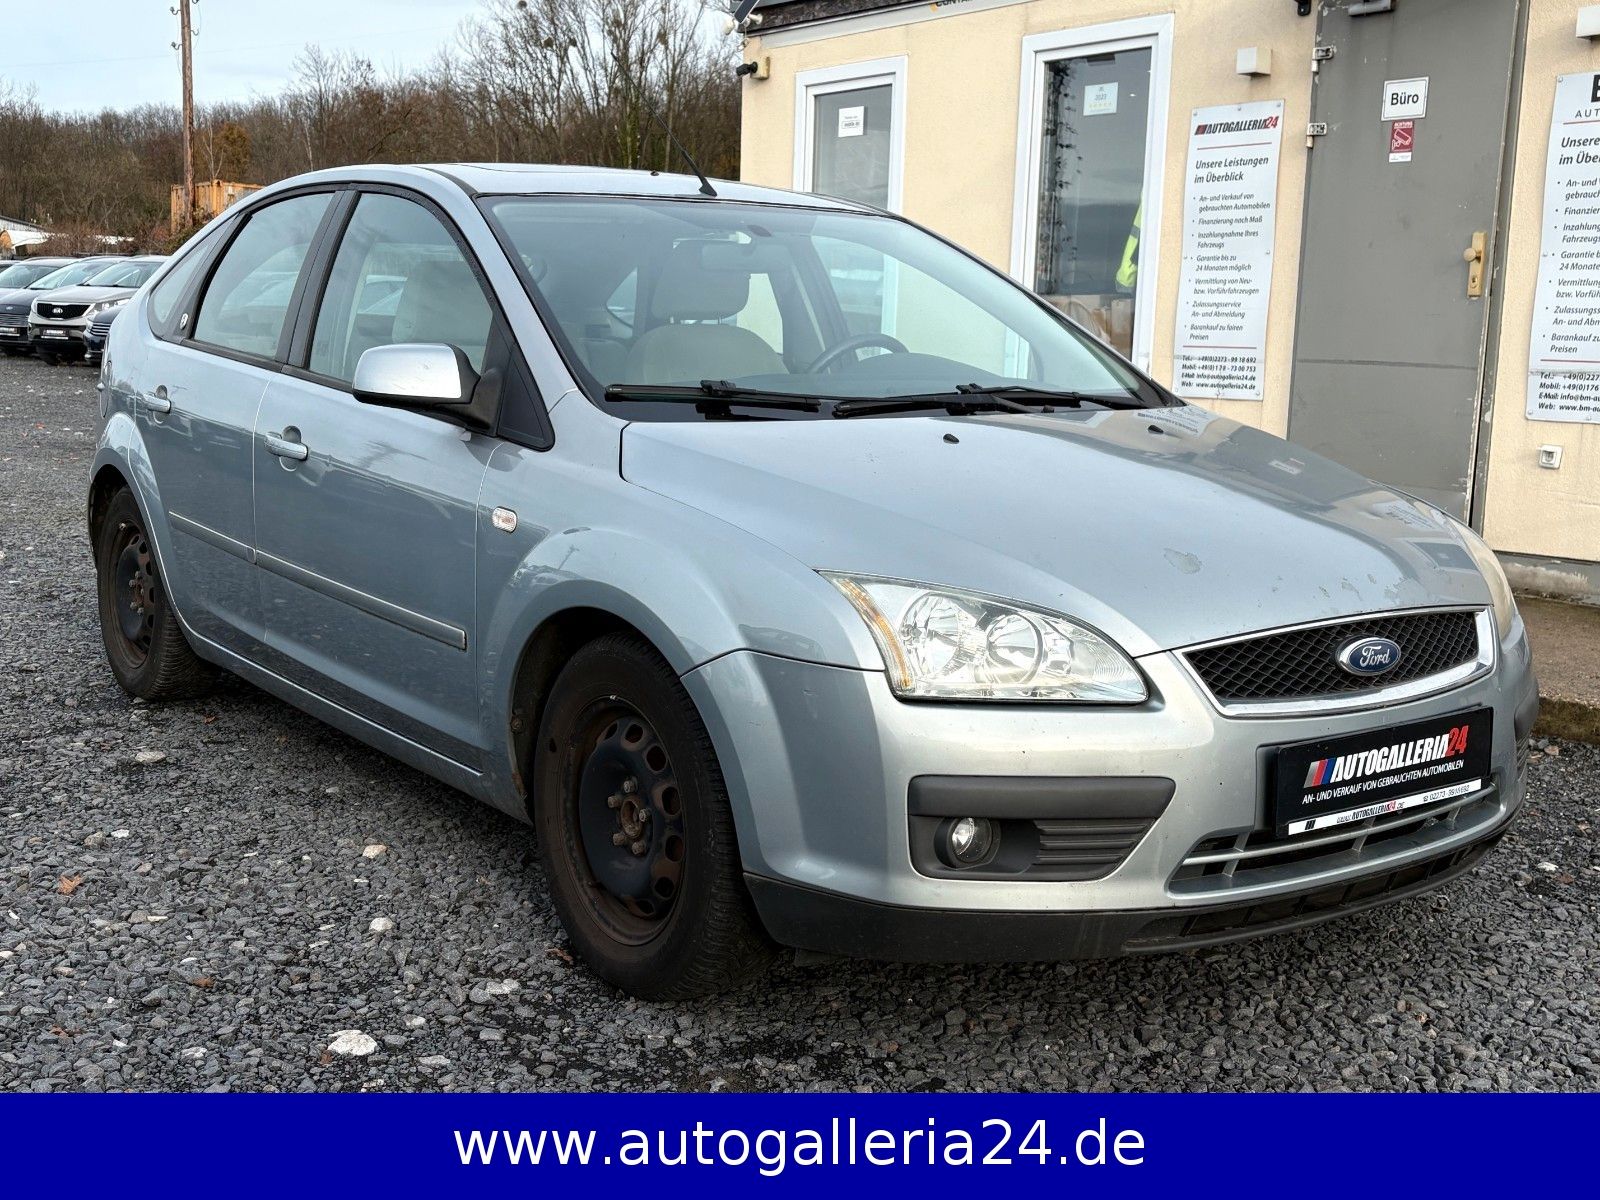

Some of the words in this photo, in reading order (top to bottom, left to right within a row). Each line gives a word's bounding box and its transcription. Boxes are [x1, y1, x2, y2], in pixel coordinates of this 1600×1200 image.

[1391, 92, 1419, 105] Büro
[1206, 115, 1279, 134] AUTOGALLERIA24
[1561, 136, 1600, 148] Unsere
[1559, 154, 1573, 165] im
[1576, 151, 1600, 164] Übe
[1195, 160, 1222, 169] Unsere
[1223, 157, 1269, 168] Leistungen
[1194, 174, 1204, 184] im
[1206, 171, 1244, 183] Überblick
[1566, 179, 1580, 187] An-
[1581, 178, 1598, 187] und
[1209, 194, 1221, 202] und
[1221, 193, 1243, 201] Verkauf
[1198, 204, 1233, 213] gebrauchten
[1233, 202, 1271, 210] Automobilen
[1198, 218, 1233, 227] Finanzierung
[1197, 230, 1244, 240] Inzahlungnahme
[1220, 254, 1229, 262] bis
[1560, 251, 1595, 259] Garantie
[1229, 264, 1252, 272] möglich
[1559, 263, 1569, 271] 24
[1194, 278, 1227, 286] Vermittlung
[1207, 287, 1260, 296] Vorführfahrzeugen
[1556, 290, 1573, 298] bzw.
[1192, 300, 1241, 309] Zulassungsservice
[1212, 311, 1245, 319] Abmeldung
[1567, 317, 1583, 326] und
[1551, 333, 1592, 342] Barankauf
[1550, 344, 1578, 353] Preisen
[1539, 382, 1561, 390] Mobil:
[1538, 402, 1556, 410] Web:
[1360, 646, 1390, 667] Ford
[1330, 725, 1469, 783] AUTOGALLERIA24
[1302, 794, 1315, 805] AN-
[1316, 790, 1332, 801] UND
[1333, 783, 1362, 798] VERKAUF
[1362, 779, 1378, 791] VON
[1377, 769, 1422, 788] GEBRAUCHTEN
[1422, 759, 1464, 777] AUTOMOBILEN
